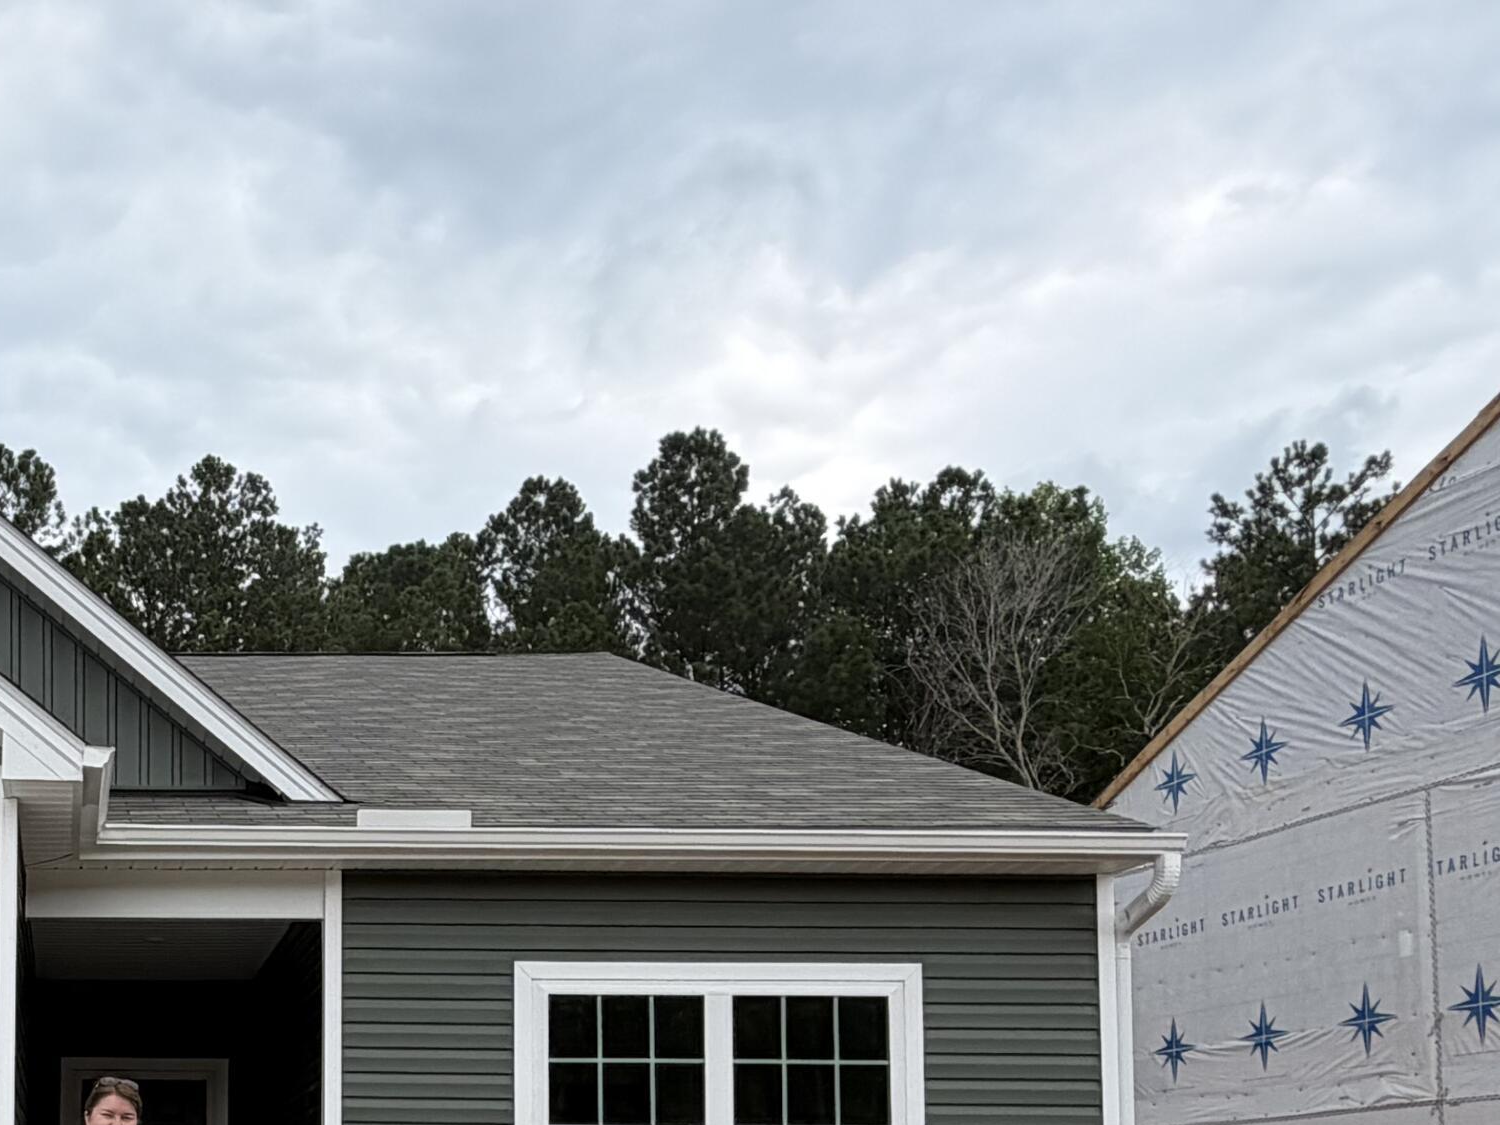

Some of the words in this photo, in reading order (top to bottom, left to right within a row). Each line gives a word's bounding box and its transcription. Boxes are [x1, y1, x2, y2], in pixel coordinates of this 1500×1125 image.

[1137, 917, 1205, 947] STARLIGHT
[1221, 894, 1298, 927] STARLIGHT
[1317, 868, 1407, 903] STARLIGHT
